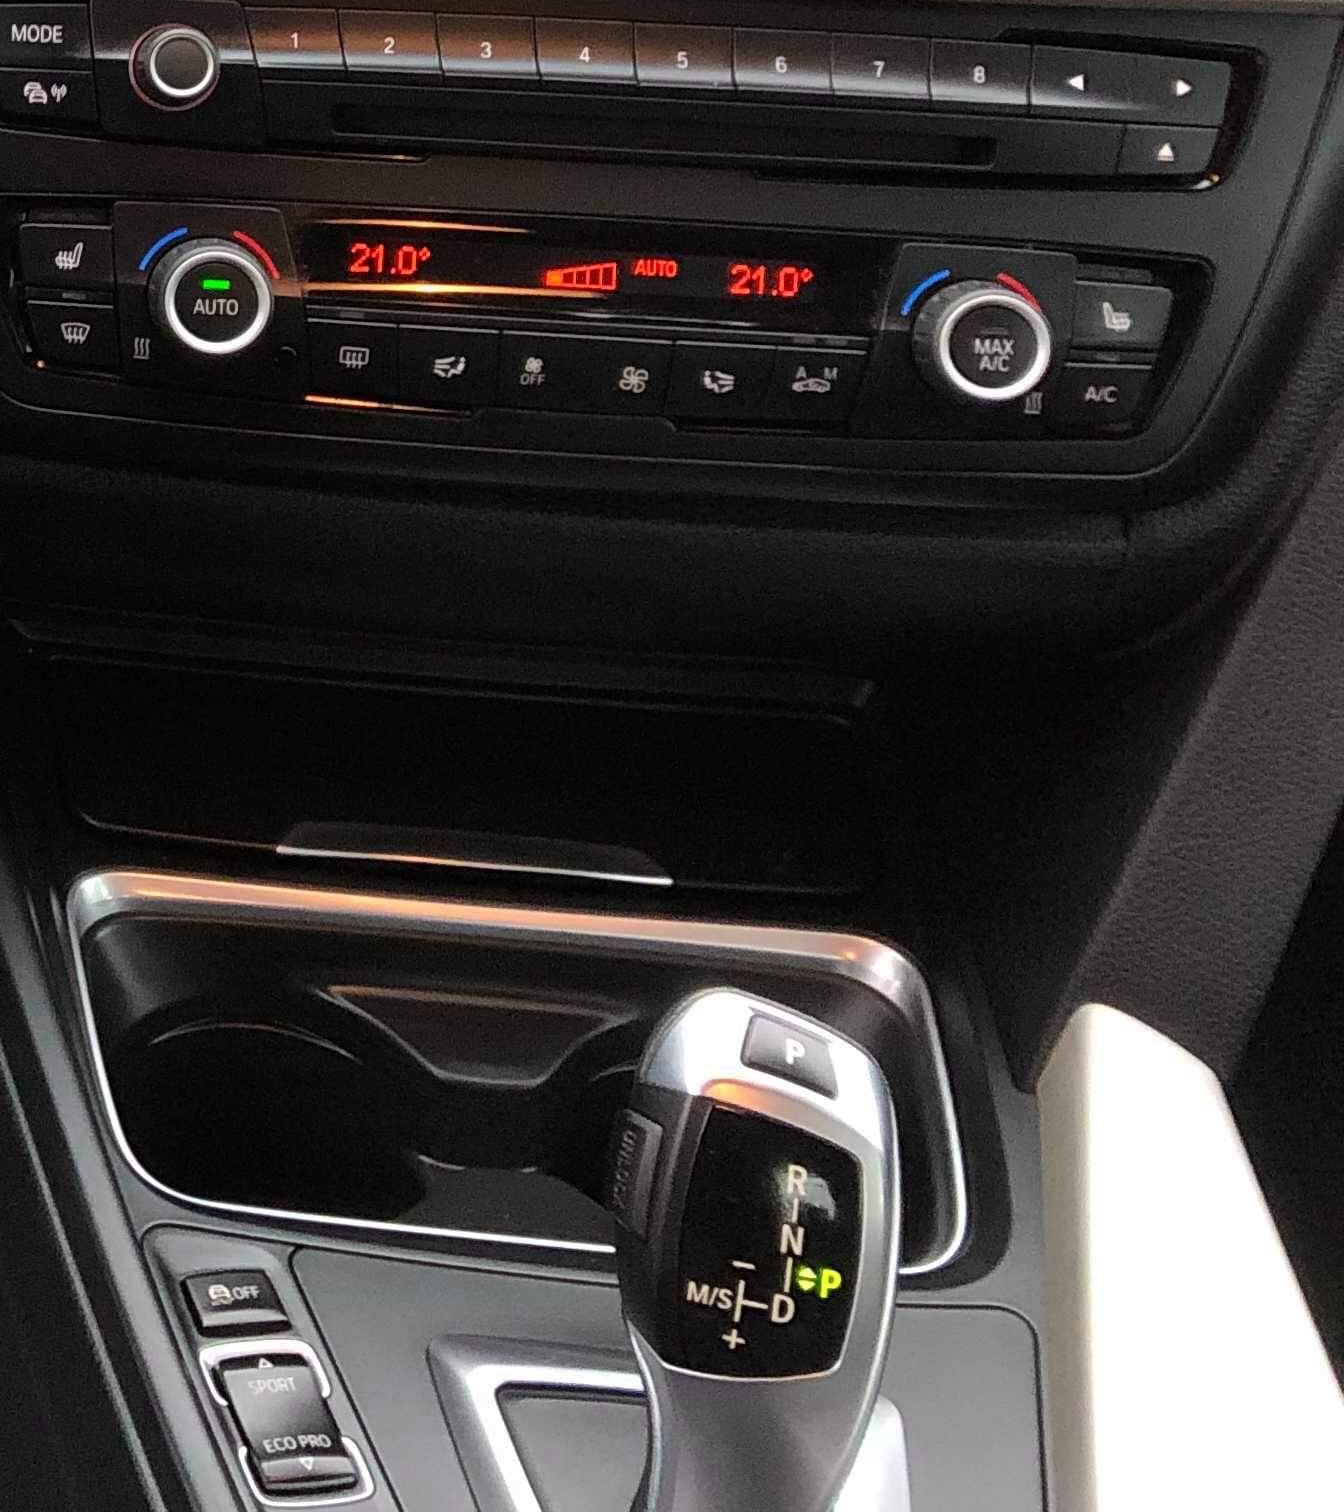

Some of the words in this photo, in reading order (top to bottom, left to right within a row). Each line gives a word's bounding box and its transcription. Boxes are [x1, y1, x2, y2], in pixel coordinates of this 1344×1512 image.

[11, 23, 63, 45] MODE
[289, 32, 300, 49] 1
[383, 36, 396, 55] 2
[479, 41, 492, 59] 3
[579, 46, 591, 63] 4
[677, 51, 689, 69] 5
[774, 56, 787, 75] 6
[873, 61, 886, 78] 7
[972, 65, 986, 84] 8
[633, 259, 678, 278] AUTO
[192, 297, 239, 317] AUTO
[973, 337, 1016, 357] MAX
[978, 354, 1012, 374] A/C
[519, 371, 545, 386] OFF
[1084, 385, 1119, 405] A/C
[784, 1038, 806, 1065] P
[786, 1163, 808, 1196] R
[780, 1224, 804, 1257] N
[232, 1285, 260, 1301] OFF
[819, 1267, 842, 1299] P
[686, 1280, 733, 1311] M/S
[770, 1294, 796, 1325] D
[247, 1376, 298, 1396] SPORT
[262, 1434, 298, 1454] ECO
[299, 1433, 332, 1450] PRO
